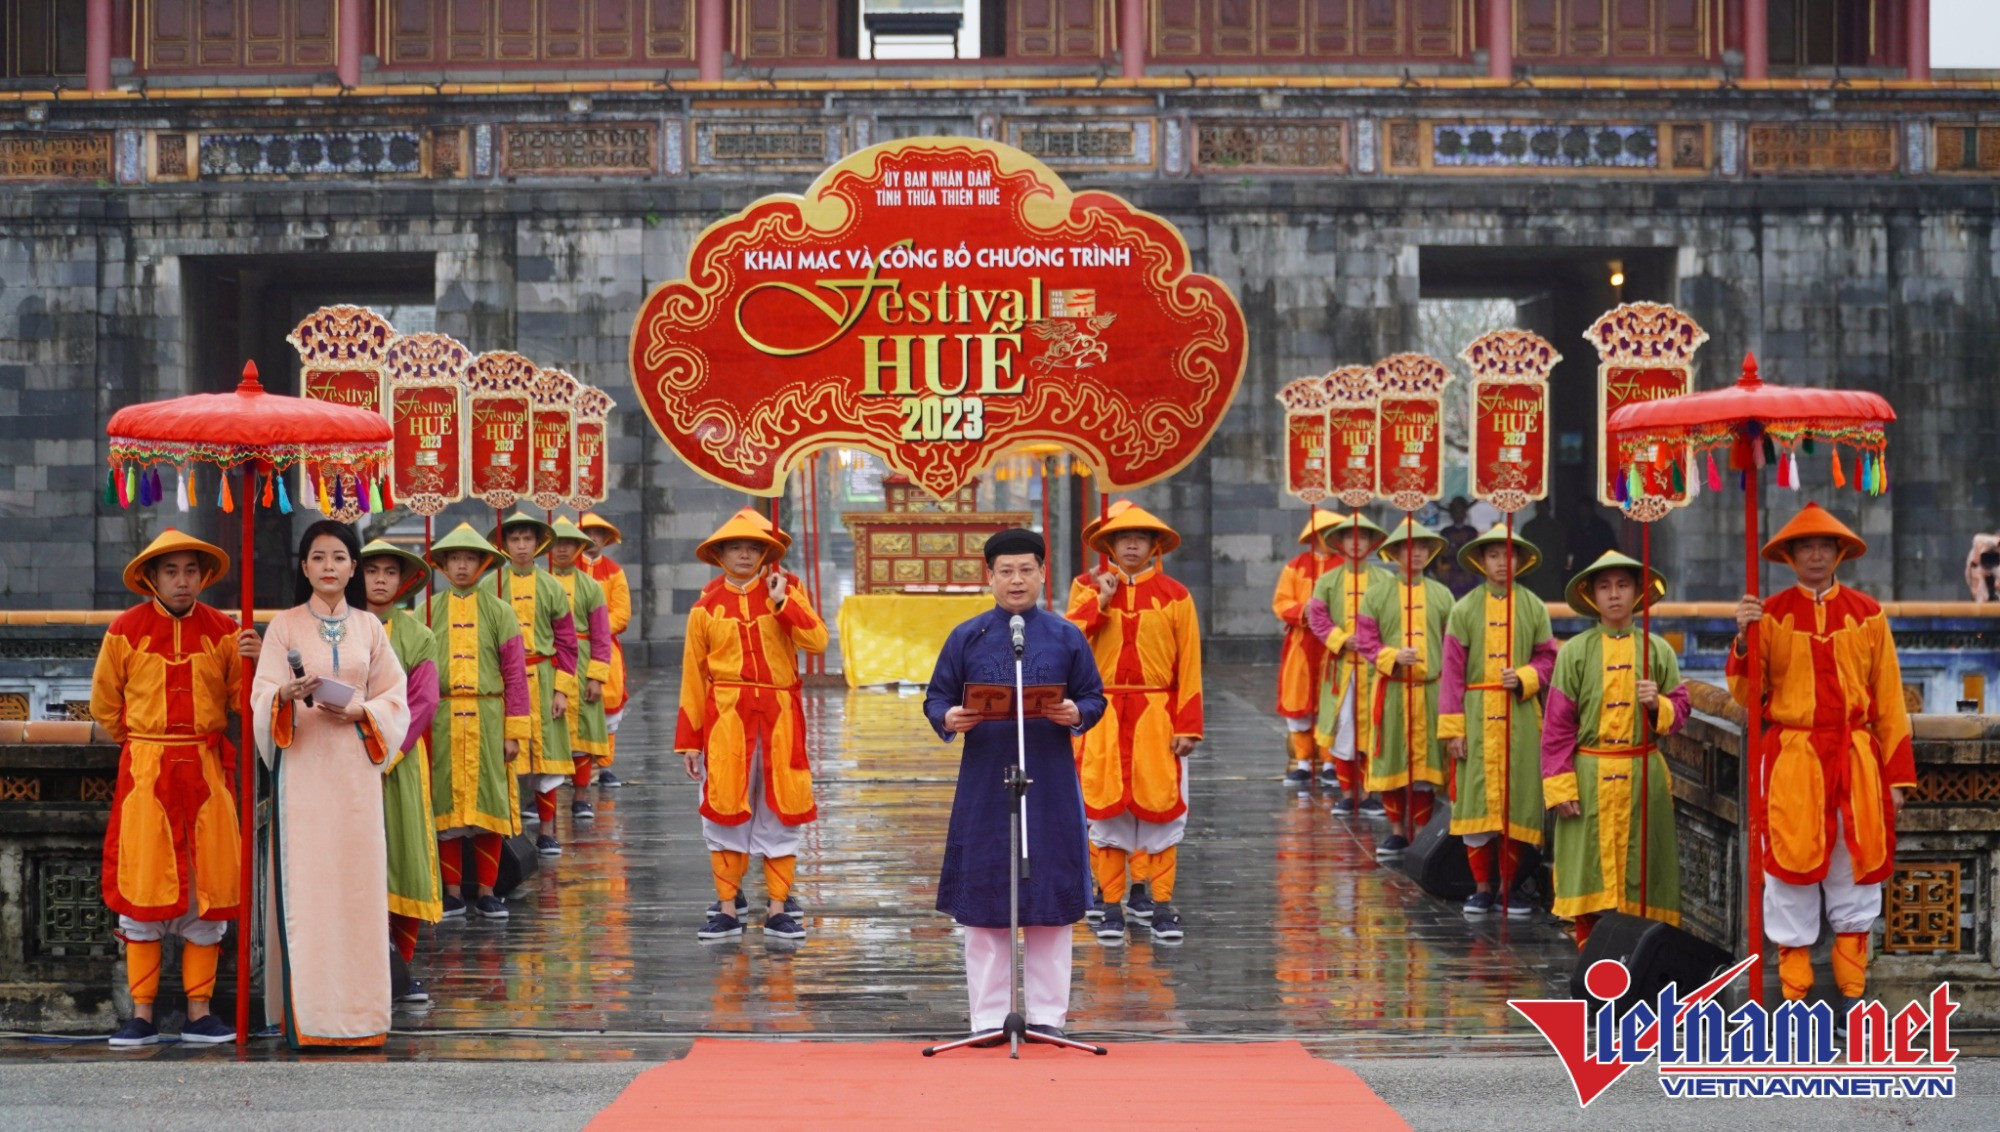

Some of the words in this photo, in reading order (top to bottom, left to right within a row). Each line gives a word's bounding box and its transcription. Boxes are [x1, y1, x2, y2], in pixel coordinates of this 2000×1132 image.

[904, 171, 927, 187] BAN
[931, 169, 963, 187] NHÂN
[967, 168, 991, 187] DÂN
[941, 186, 973, 206] THIÊN
[978, 186, 1000, 206] HUẾ
[744, 250, 792, 270] KHAI
[799, 249, 841, 273] MẠC
[848, 245, 874, 269] VÀ
[879, 245, 937, 269] CÔNG
[943, 241, 971, 268] BỐ
[977, 247, 1064, 268] CHƯƠNG
[1069, 244, 1130, 267] TRÌNH
[735, 238, 1044, 356] Festival
[859, 321, 1025, 396] HUẾ
[902, 397, 985, 441] 2023
[420, 435, 442, 448] 2023
[494, 439, 515, 452] 2023
[1301, 434, 1324, 448] HU
[1503, 432, 1527, 446] 2023
